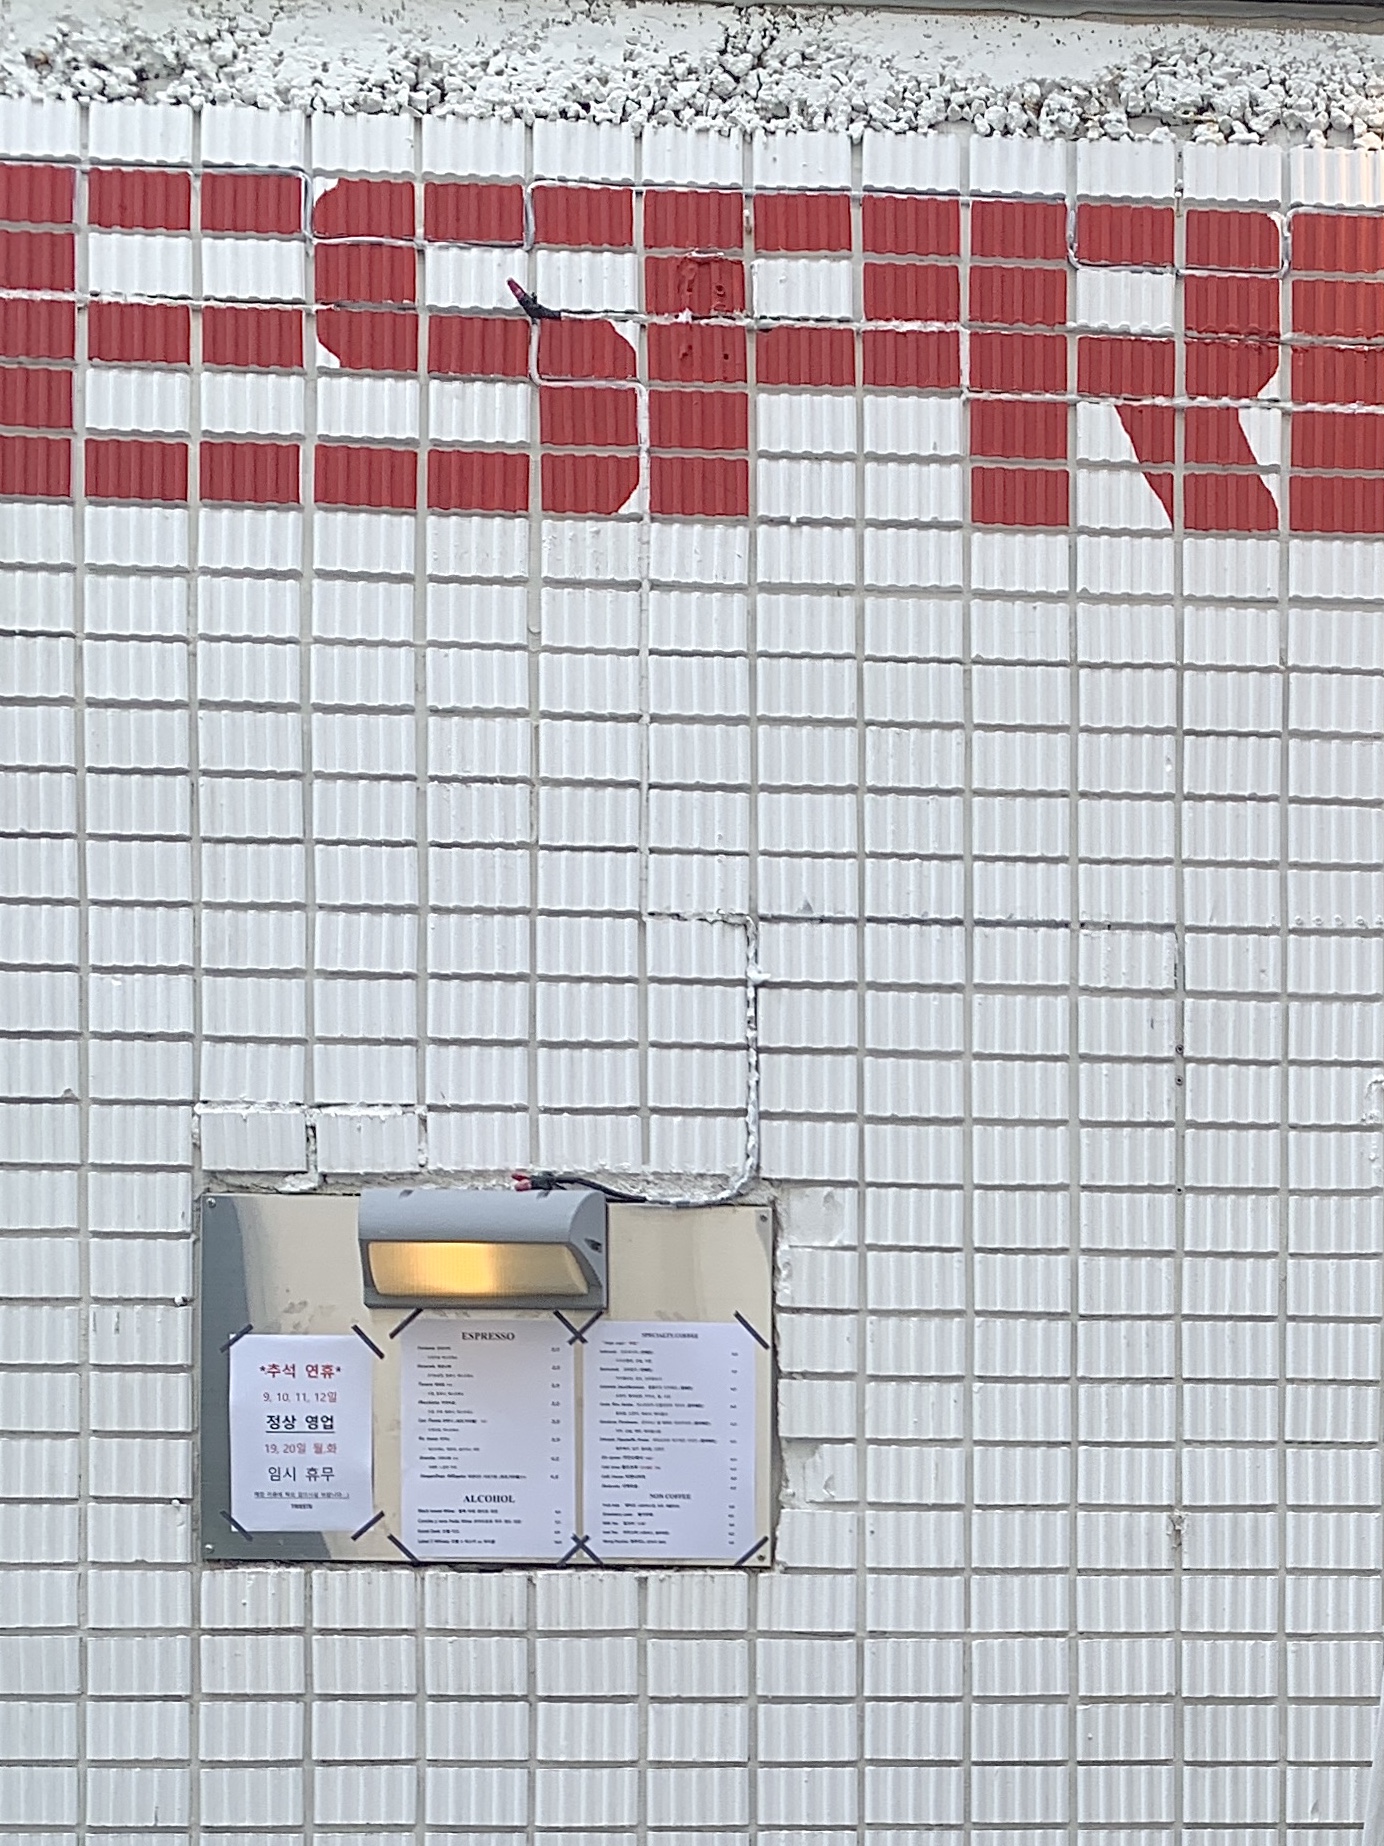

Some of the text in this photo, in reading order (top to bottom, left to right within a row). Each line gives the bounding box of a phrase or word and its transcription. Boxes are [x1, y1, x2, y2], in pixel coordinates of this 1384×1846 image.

[461, 1331, 516, 1341] ESPRESSO
[266, 1415, 335, 1430] 정상 영업
[267, 1467, 336, 1482] 임시 휴무
